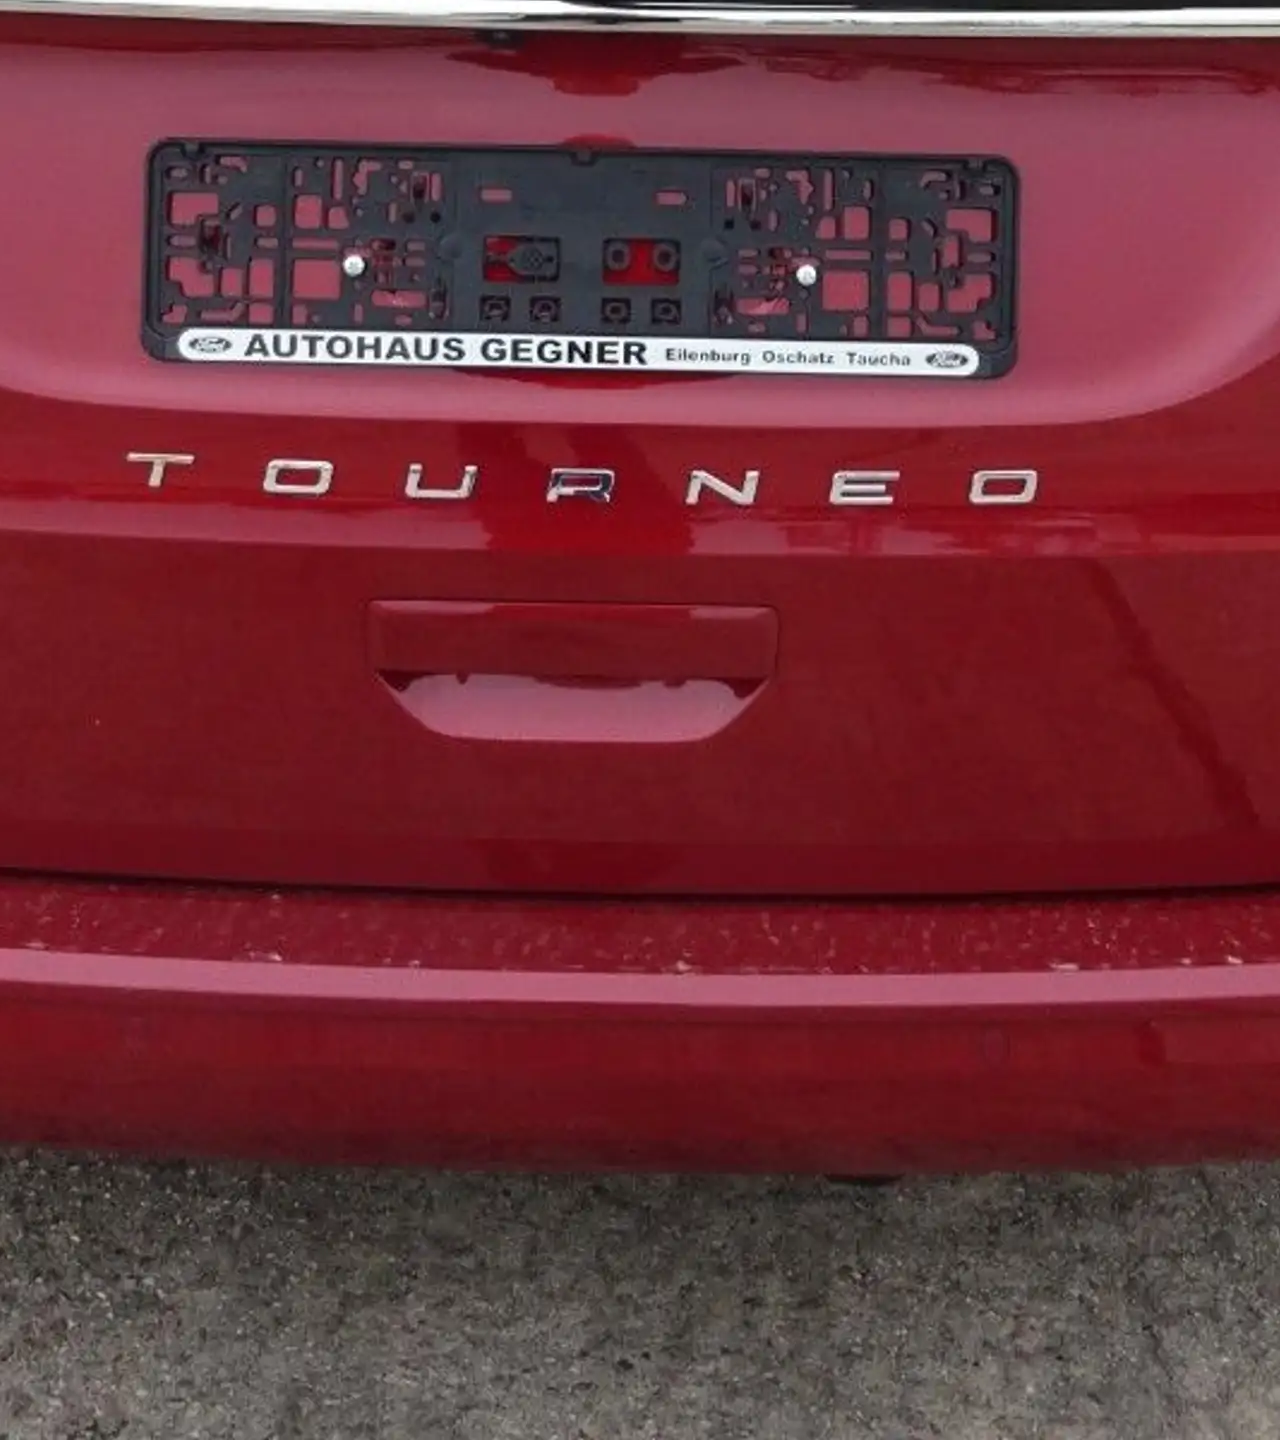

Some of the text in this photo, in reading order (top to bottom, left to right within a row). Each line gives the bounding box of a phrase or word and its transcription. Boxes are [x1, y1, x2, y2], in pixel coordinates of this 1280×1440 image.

[244, 334, 466, 361] AUTOHAUS
[480, 338, 648, 365] GEGNER
[665, 348, 752, 366] Eilenburg
[762, 350, 835, 364] Oschatz
[846, 352, 912, 367] Taucha
[126, 452, 1038, 505] TOURNEO
